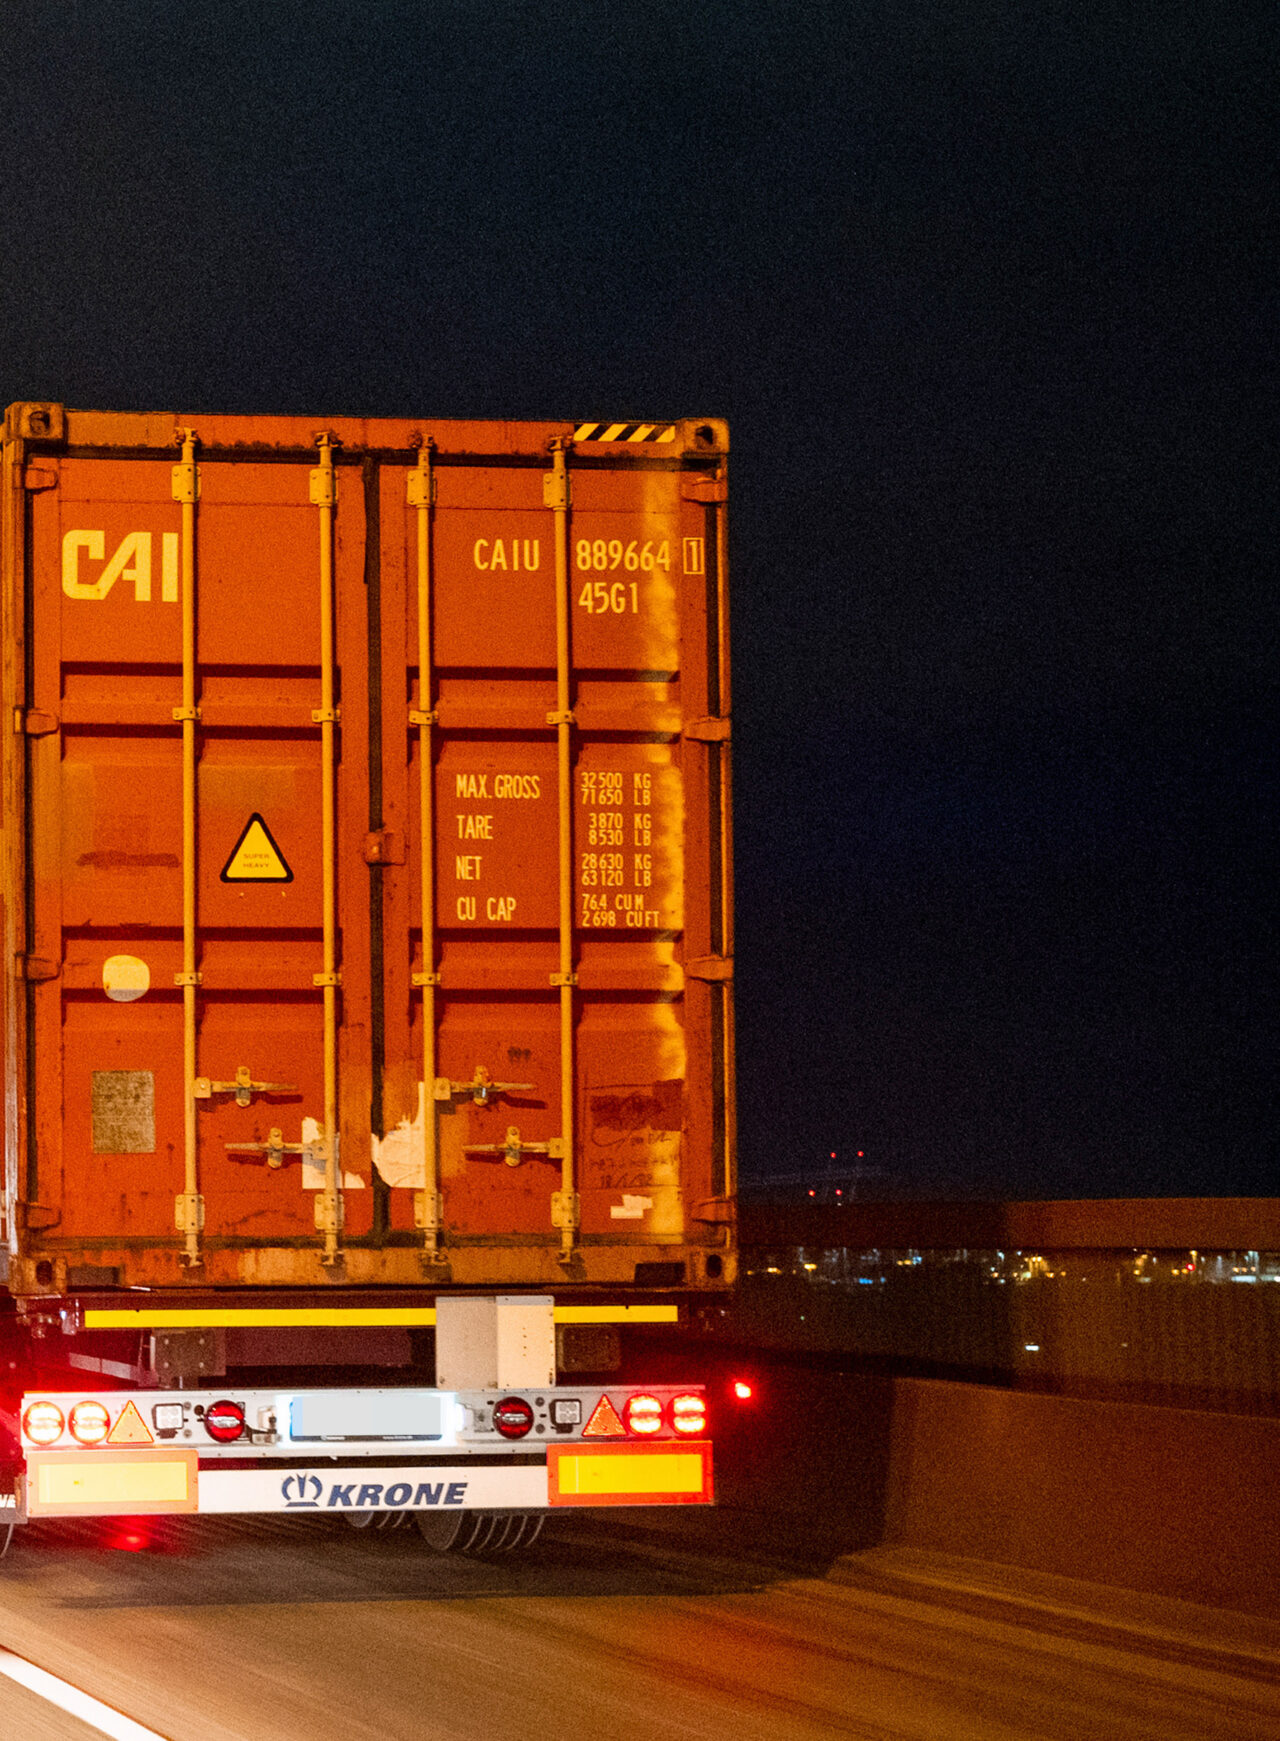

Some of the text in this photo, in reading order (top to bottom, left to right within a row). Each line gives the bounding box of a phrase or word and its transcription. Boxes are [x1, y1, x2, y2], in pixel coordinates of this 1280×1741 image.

[62, 529, 178, 602] CAI
[474, 539, 540, 571] CAIU
[576, 540, 670, 571] 889664
[579, 582, 638, 614] 45G1
[581, 772, 622, 788] 32500
[634, 773, 651, 789] KG
[581, 789, 651, 805] 71650 LB
[457, 813, 651, 839] TARE 3870 KG
[589, 830, 651, 846] 8530 LB
[457, 854, 652, 880] NET 28630 KG
[582, 870, 651, 886] 63120 LB
[457, 897, 475, 920] CU
[487, 897, 516, 921] CAP
[327, 1483, 468, 1506] KRONE
